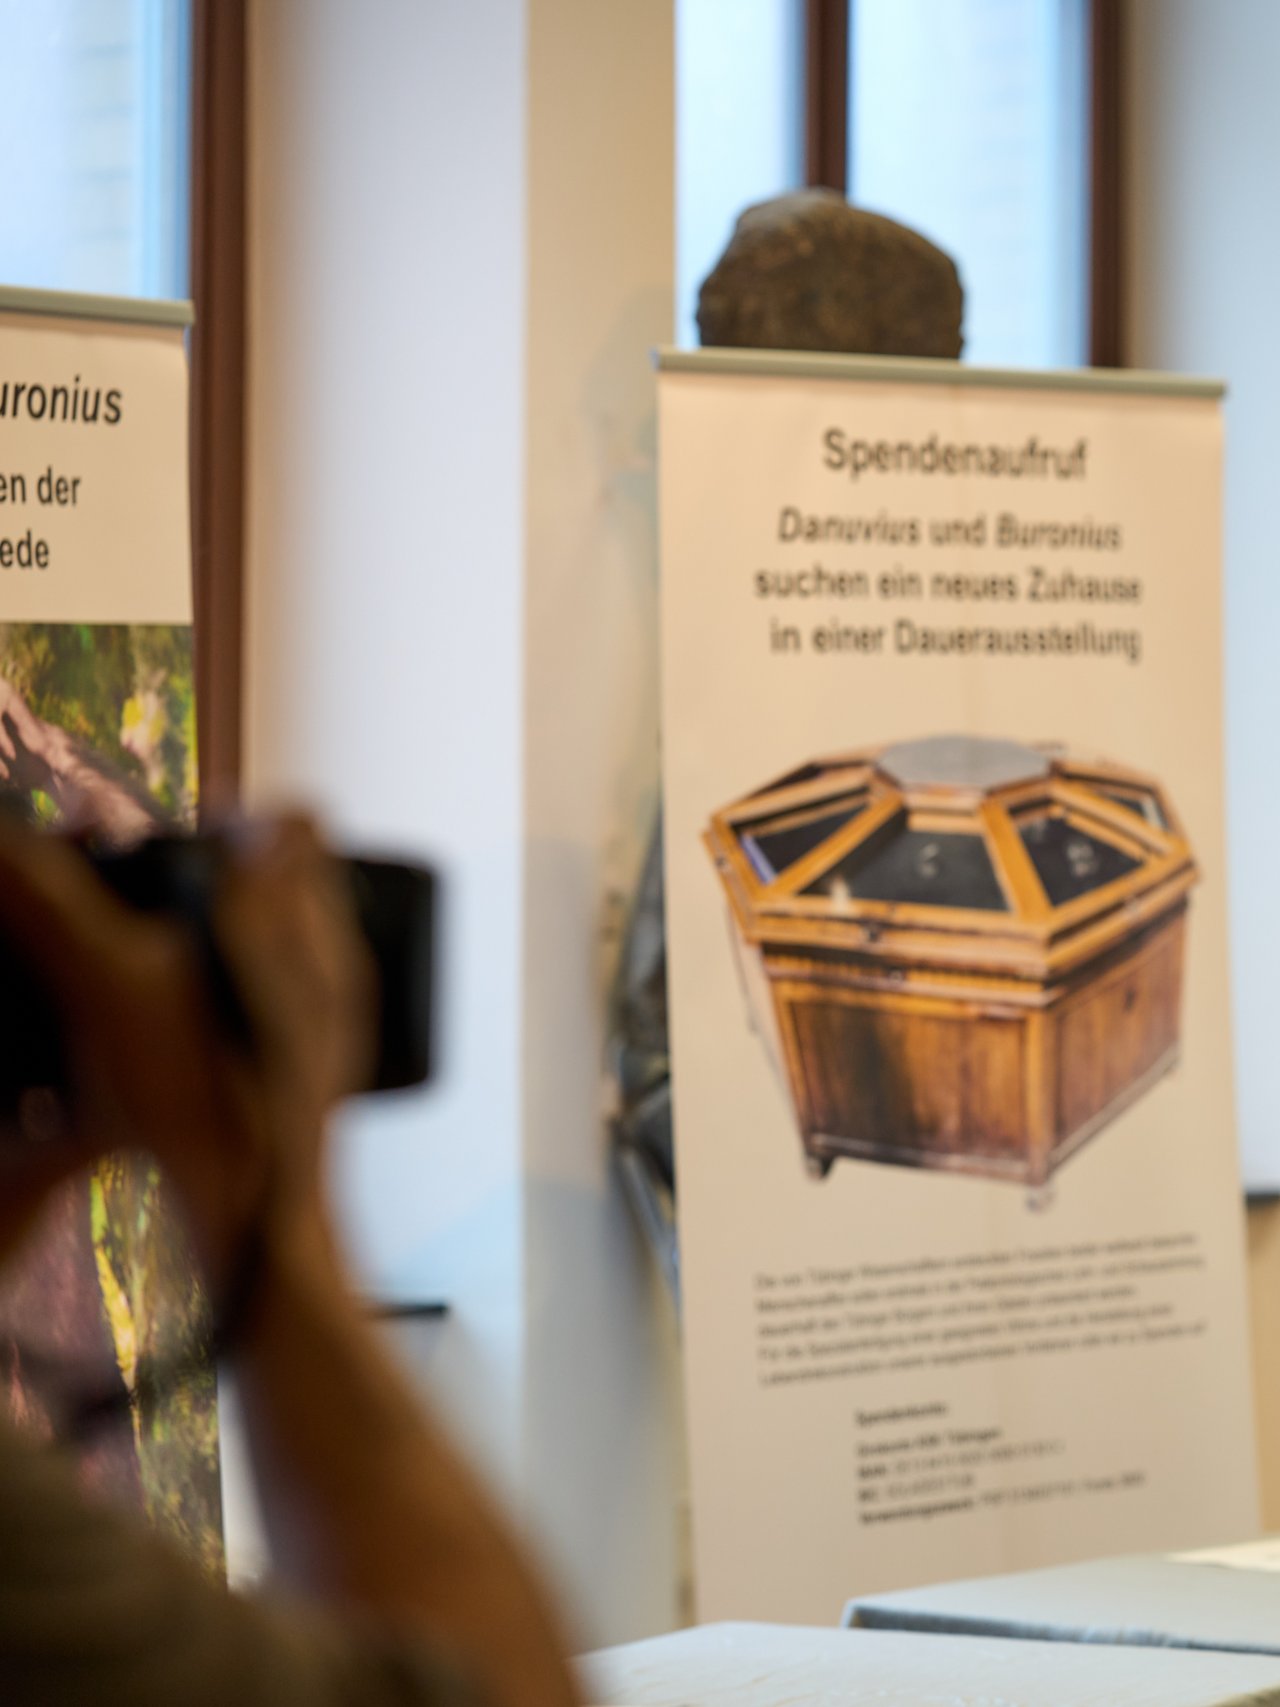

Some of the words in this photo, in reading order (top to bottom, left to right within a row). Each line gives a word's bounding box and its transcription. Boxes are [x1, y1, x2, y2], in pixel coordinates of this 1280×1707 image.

[823, 427, 1088, 480] Spendenaufruf
[37, 465, 81, 506] der
[778, 507, 920, 546] Danuvius
[930, 512, 986, 547] und
[997, 513, 1122, 550] Buronius
[755, 564, 869, 599] suchen
[878, 565, 924, 600] ein
[931, 570, 1019, 601] neues
[1028, 567, 1143, 604] Zuhause
[771, 620, 802, 653] in
[813, 620, 885, 653] einer
[894, 619, 1141, 664] Dauerausstellung
